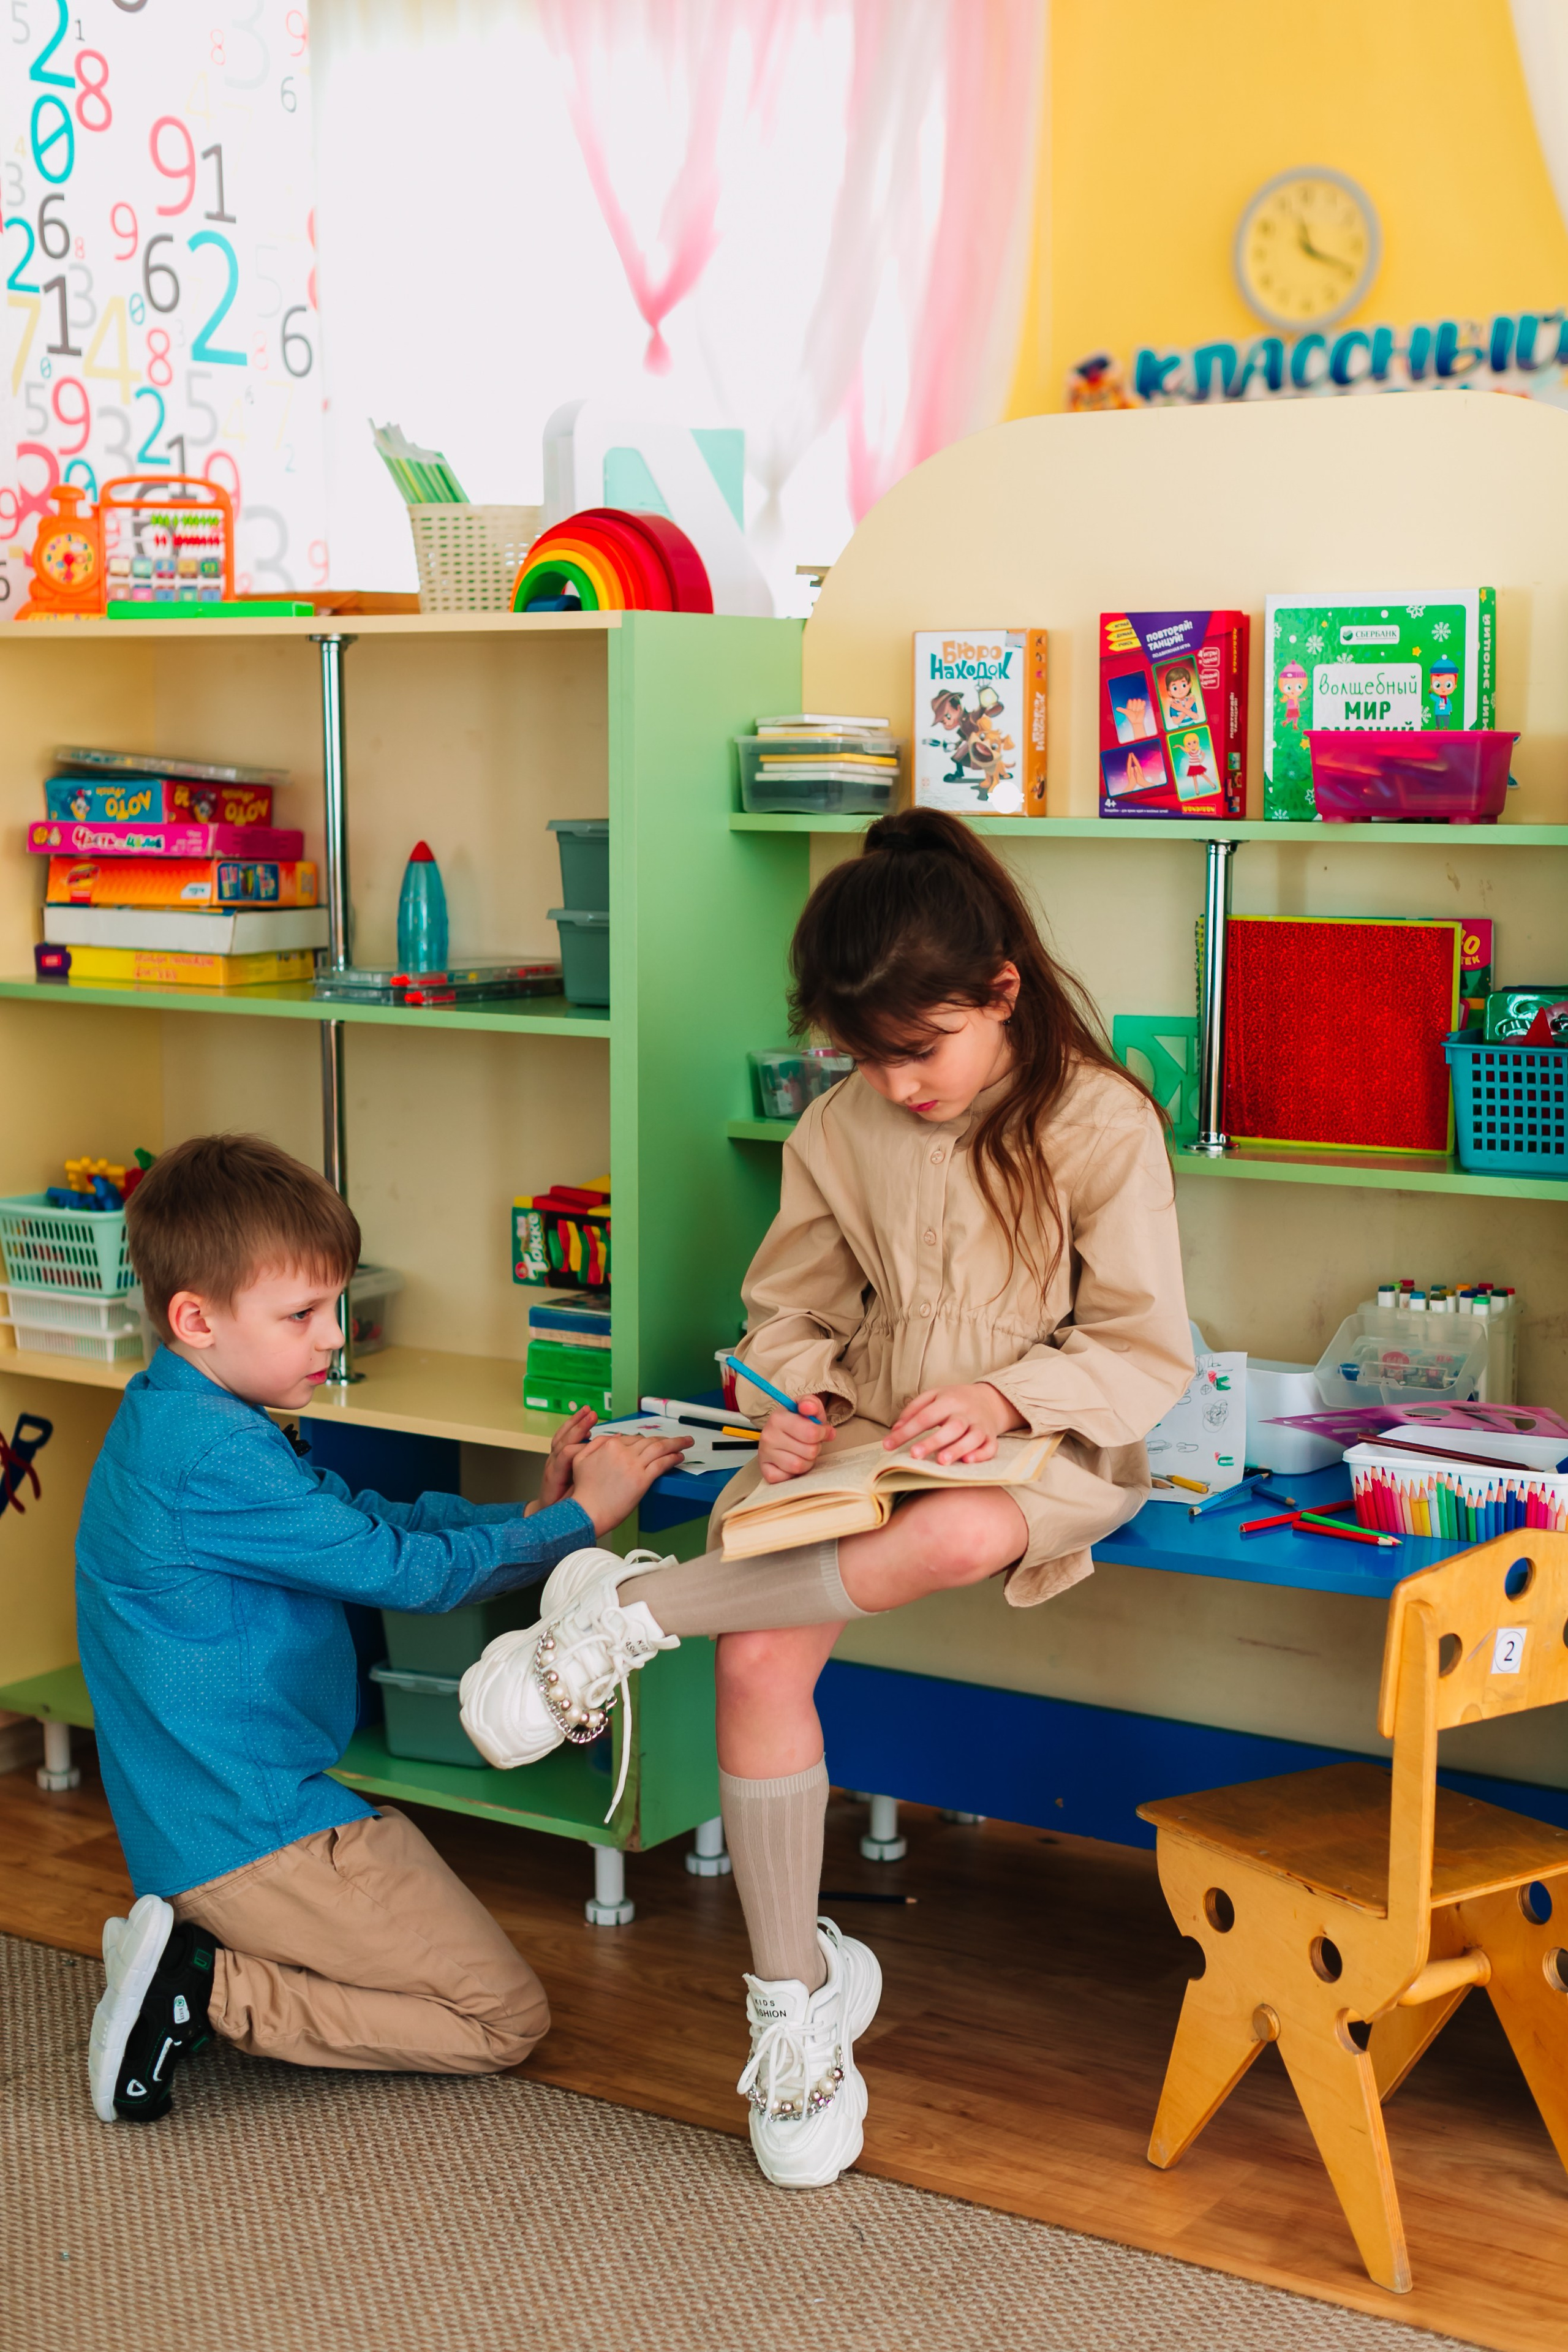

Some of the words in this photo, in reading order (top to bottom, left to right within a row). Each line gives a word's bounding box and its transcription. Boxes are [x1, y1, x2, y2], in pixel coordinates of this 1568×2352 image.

[29, 0, 75, 88] 2
[75, 19, 85, 41] 1
[210, 28, 226, 66] 8
[285, 9, 309, 57] 9
[74, 48, 112, 132] 8
[281, 76, 298, 113] 6
[30, 94, 75, 184] 0
[149, 115, 196, 216] 9
[5, 161, 26, 207] 3
[202, 143, 236, 224] 1
[4, 216, 40, 293] 2
[37, 193, 70, 260] 6
[110, 202, 138, 260] 9
[68, 263, 97, 328] 3
[142, 233, 179, 313] 6
[187, 230, 247, 366] 2
[43, 274, 81, 356] 1
[129, 293, 145, 325] 0
[281, 305, 313, 377] 6
[7, 298, 41, 398] 7
[83, 296, 141, 405] 4
[146, 328, 172, 386] 8
[24, 382, 49, 437] 5
[51, 377, 91, 456] 9
[135, 386, 170, 465] 2
[186, 370, 217, 447] 5
[166, 434, 197, 500] 1
[309, 540, 330, 586] 9
[1146, 620, 1193, 643] ПОВТОРЯЙ!
[1147, 633, 1184, 651] ТАНЦУЙ!
[1482, 614, 1491, 689] ЭМОЦИЙ
[1344, 701, 1391, 720] МИР
[1104, 798, 1117, 807] 4+
[1504, 1641, 1515, 1661] 2
[758, 2009, 786, 2018] SHION
